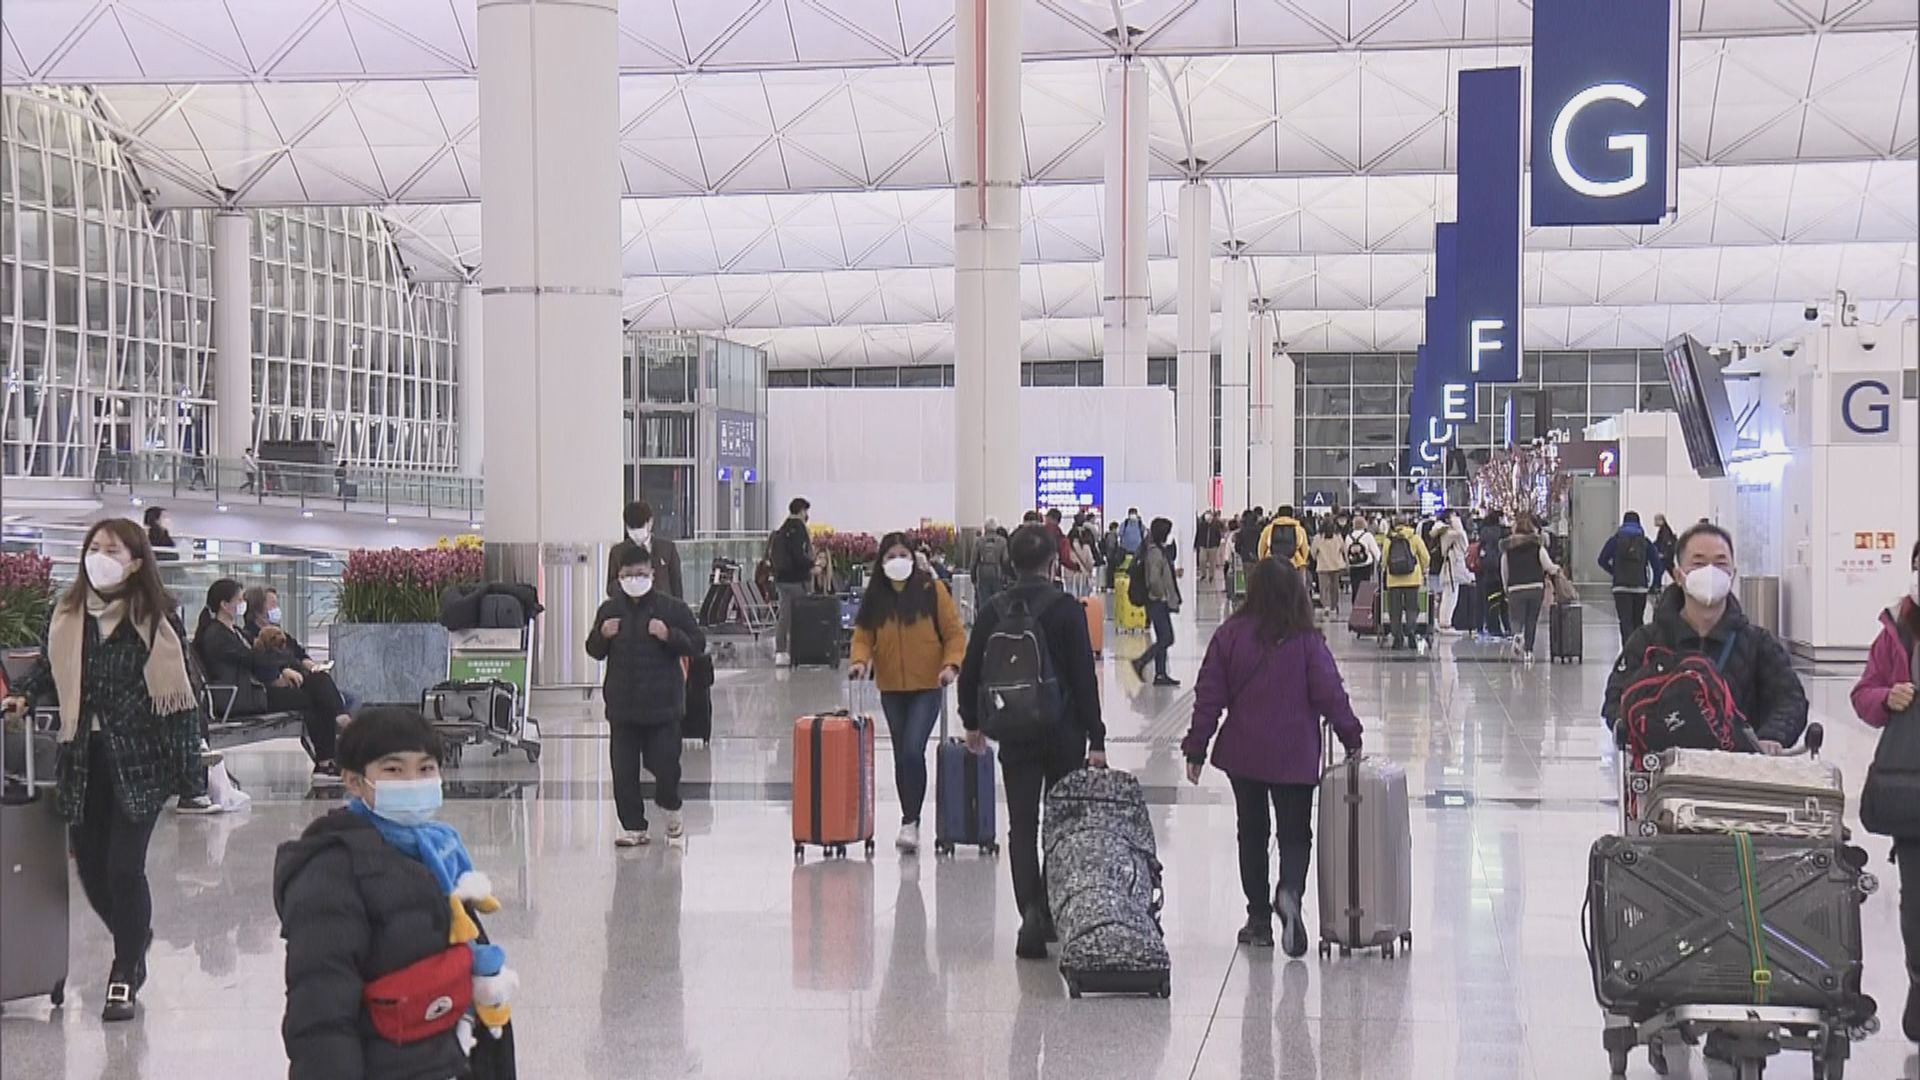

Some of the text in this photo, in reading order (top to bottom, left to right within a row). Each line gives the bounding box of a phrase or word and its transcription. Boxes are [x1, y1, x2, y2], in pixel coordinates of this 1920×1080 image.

[1550, 83, 1649, 197] G
[1470, 320, 1505, 372] F
[1444, 384, 1468, 419] E
[1842, 380, 1890, 433] G
[1314, 491, 1324, 504] A
